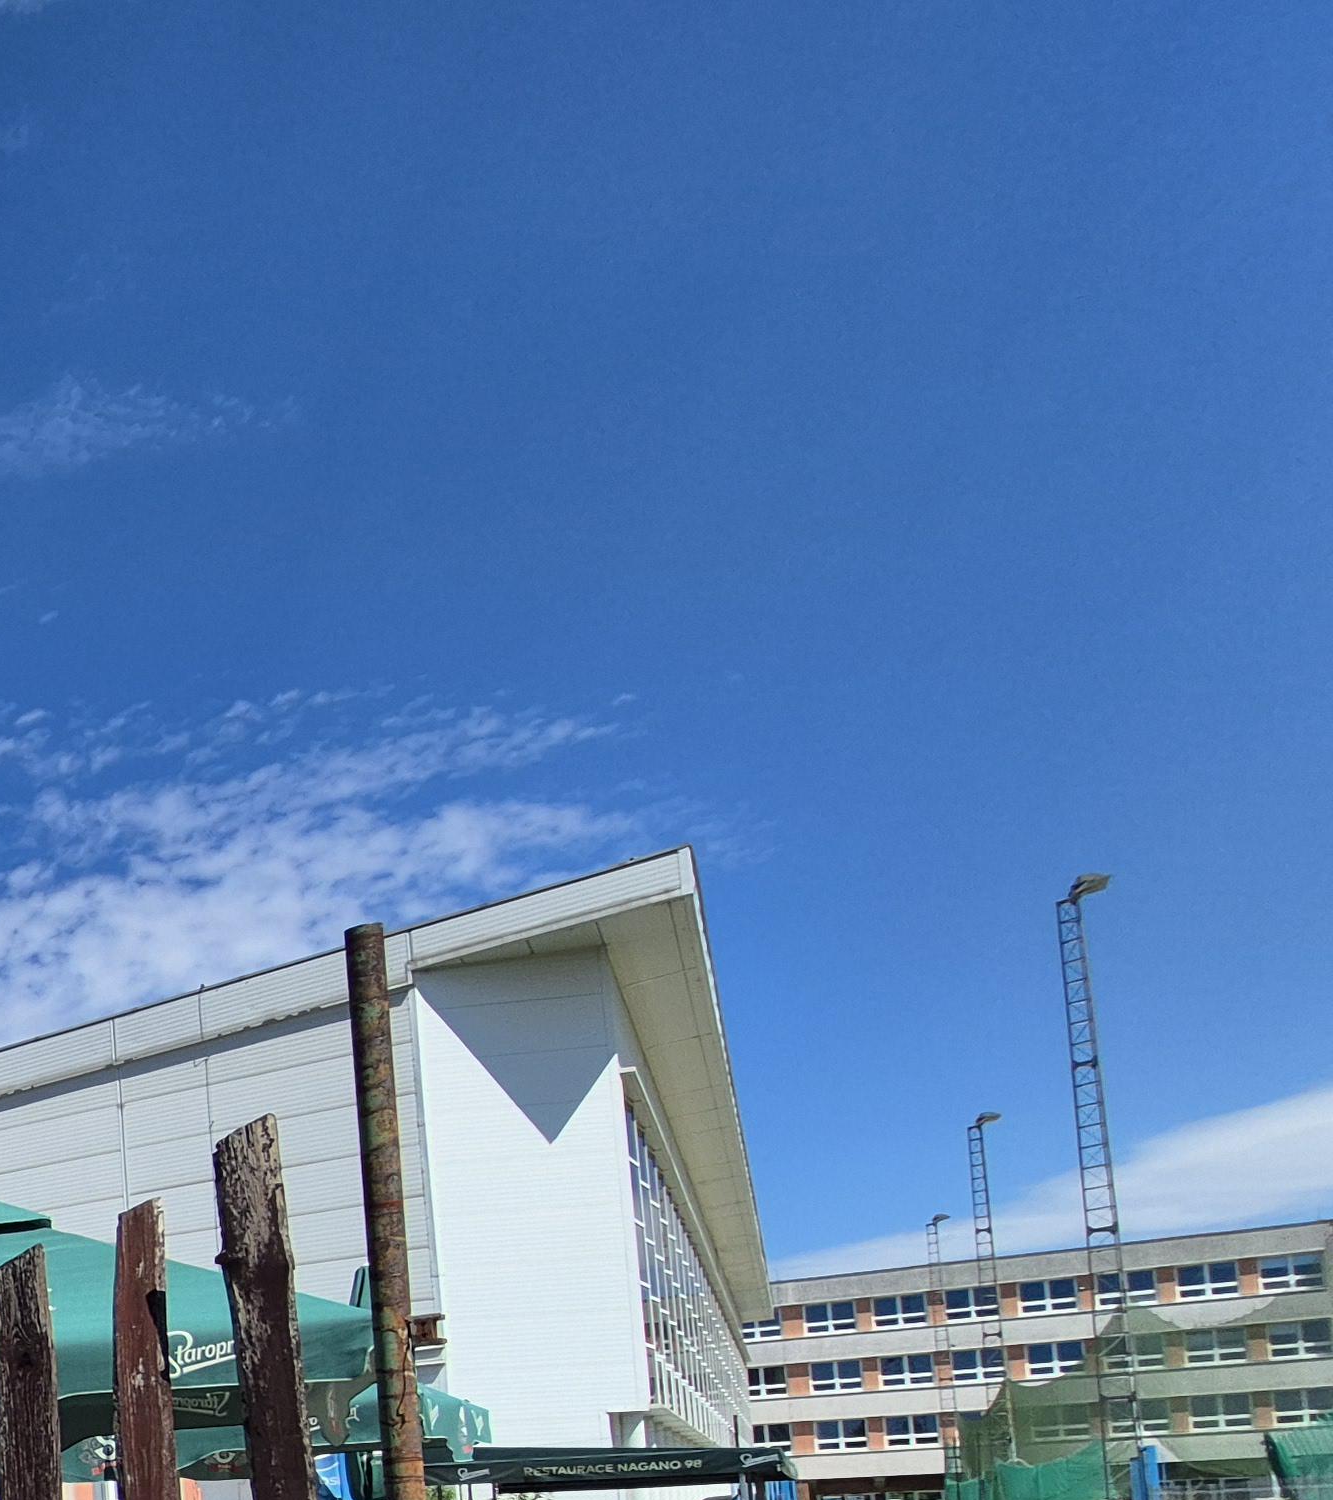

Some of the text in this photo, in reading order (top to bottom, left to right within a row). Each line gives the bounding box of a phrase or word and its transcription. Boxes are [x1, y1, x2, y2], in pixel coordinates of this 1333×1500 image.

[167, 1330, 236, 1379] Staropr
[523, 1459, 703, 1477] RESTAURACE NAGANO 98
